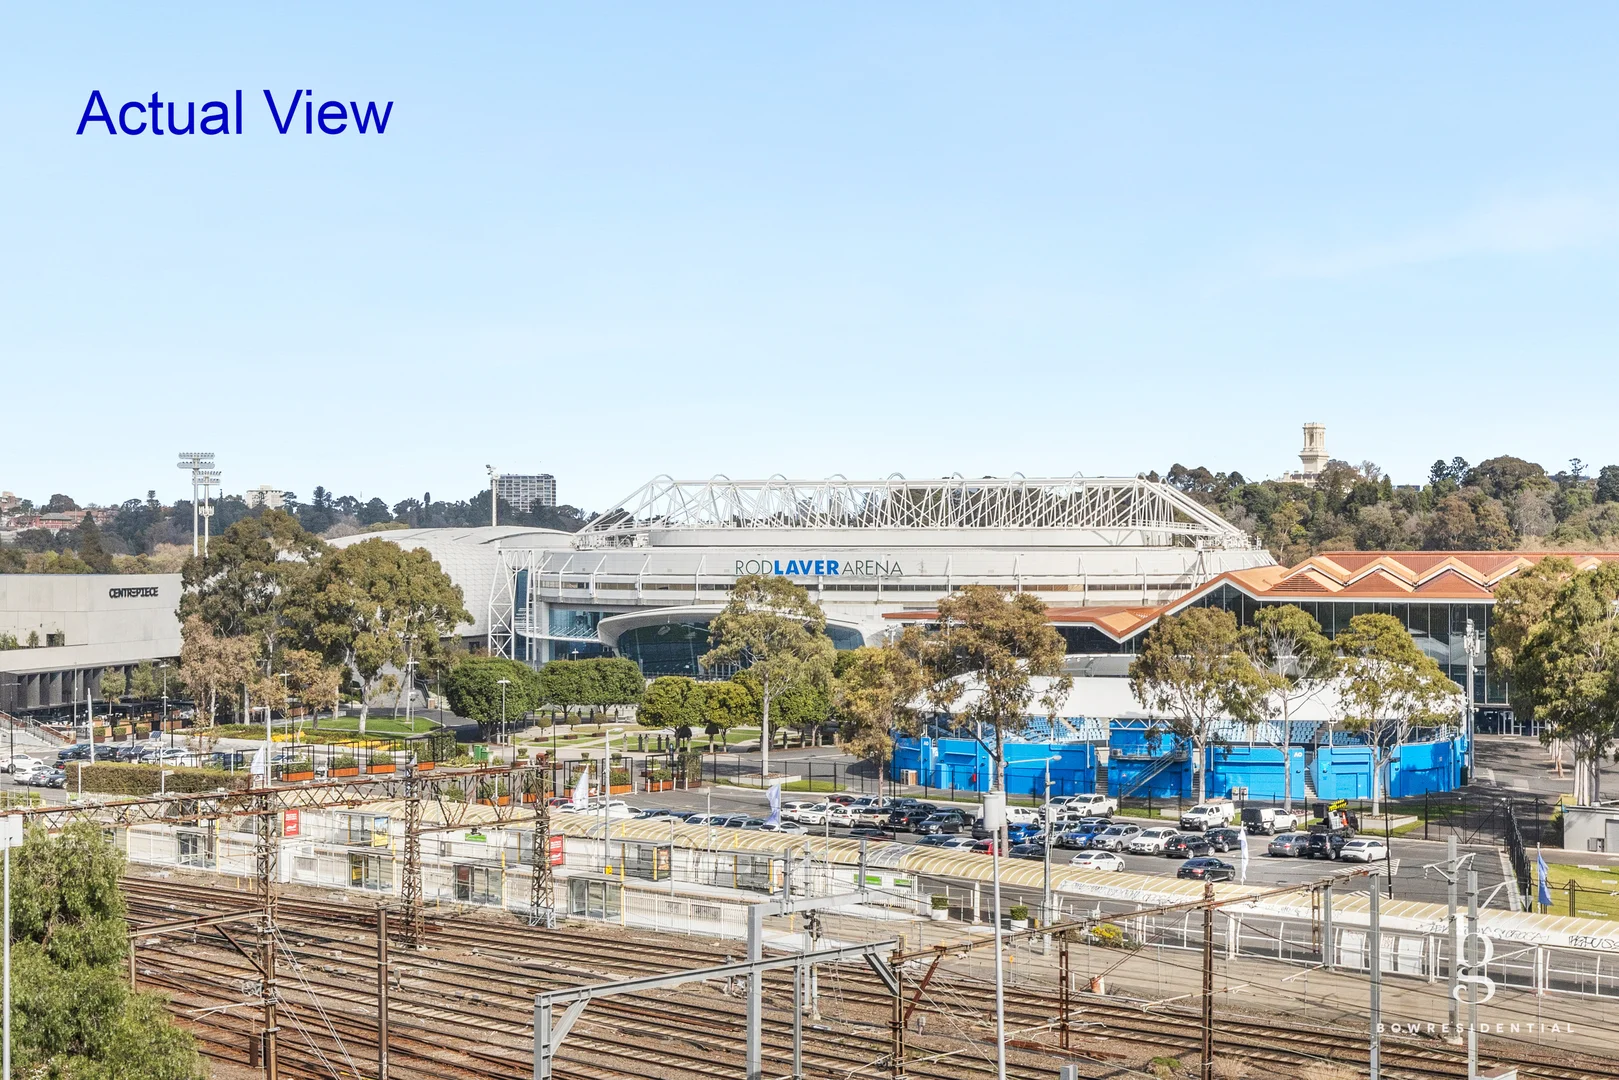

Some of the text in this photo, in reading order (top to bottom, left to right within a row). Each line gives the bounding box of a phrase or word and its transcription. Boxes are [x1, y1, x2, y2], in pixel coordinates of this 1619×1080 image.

[735, 560, 903, 576] ROD LAVER ARENA
[108, 586, 159, 599] CENTREPIECE
